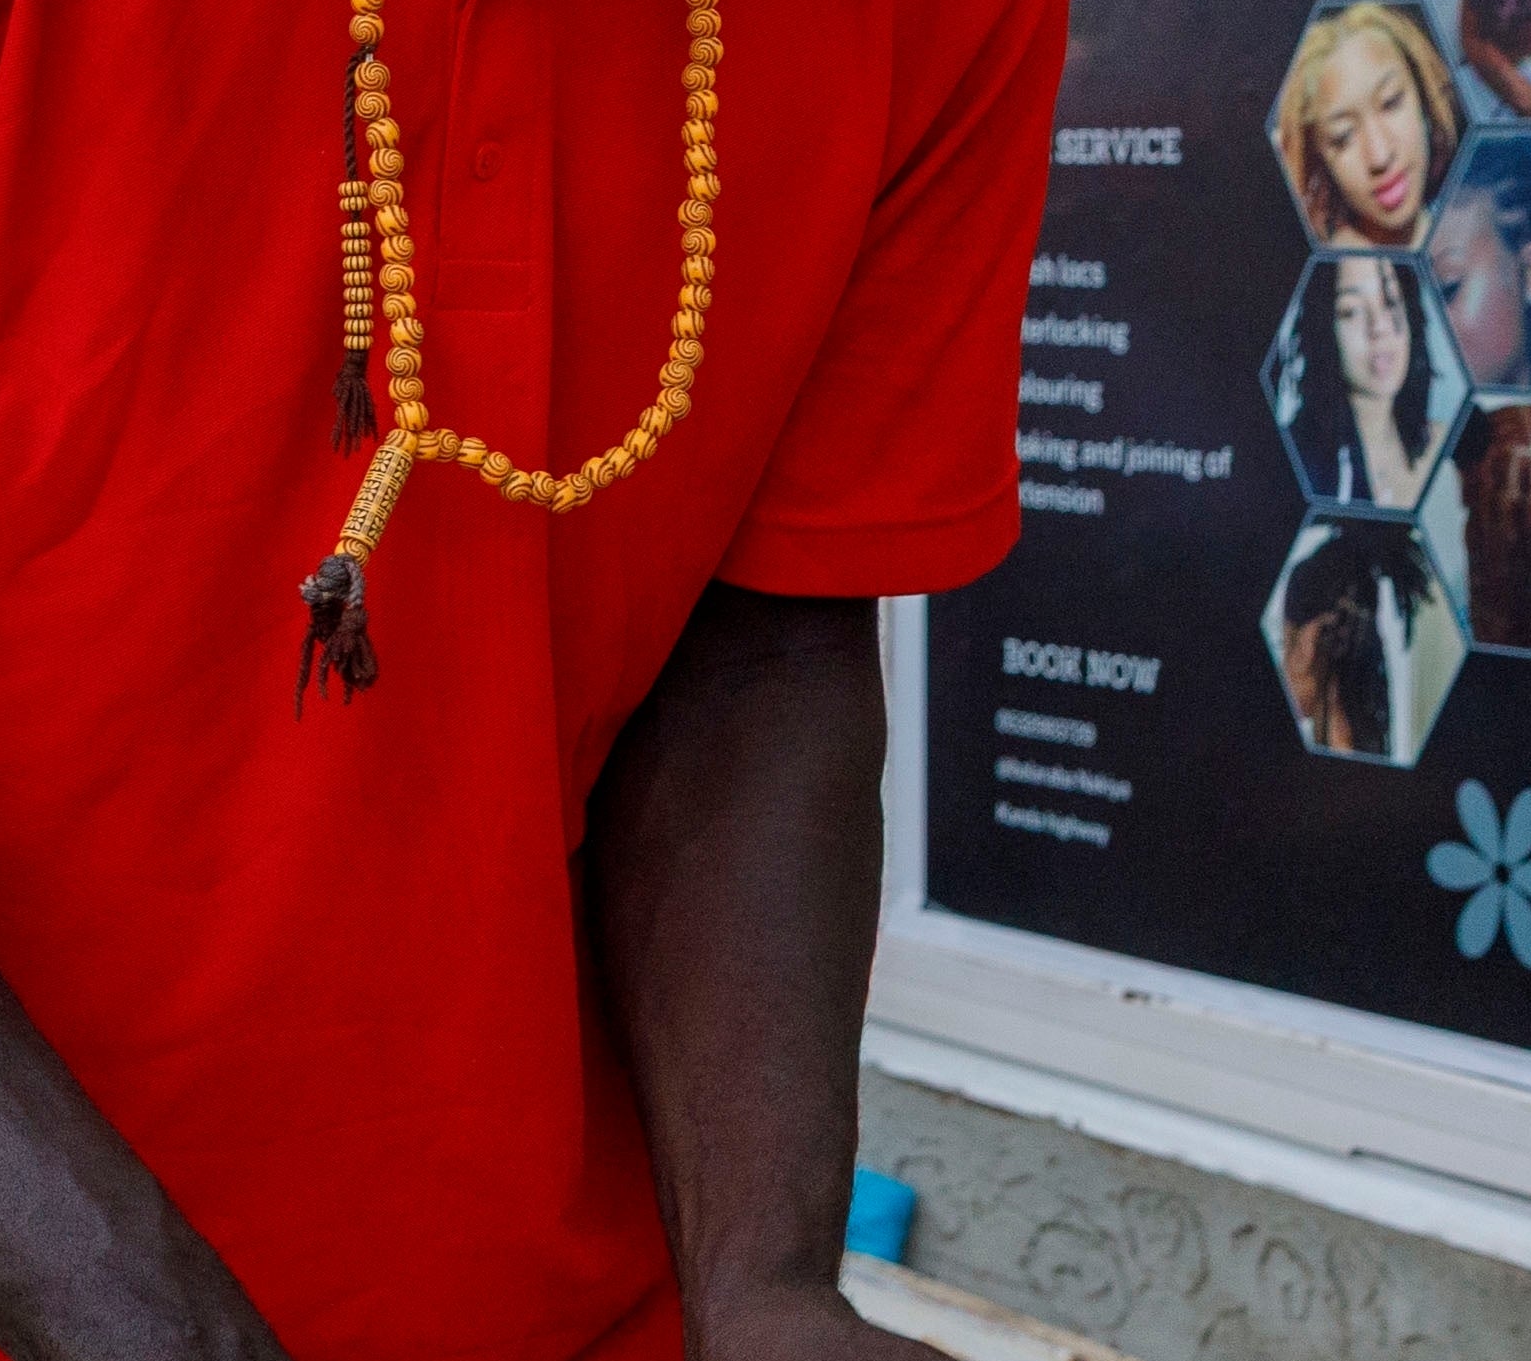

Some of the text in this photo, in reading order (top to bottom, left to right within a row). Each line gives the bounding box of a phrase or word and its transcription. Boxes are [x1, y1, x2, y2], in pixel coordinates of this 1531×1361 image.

[1054, 127, 1183, 165] SERVICE
[1003, 638, 1161, 694] BOOK NOW
